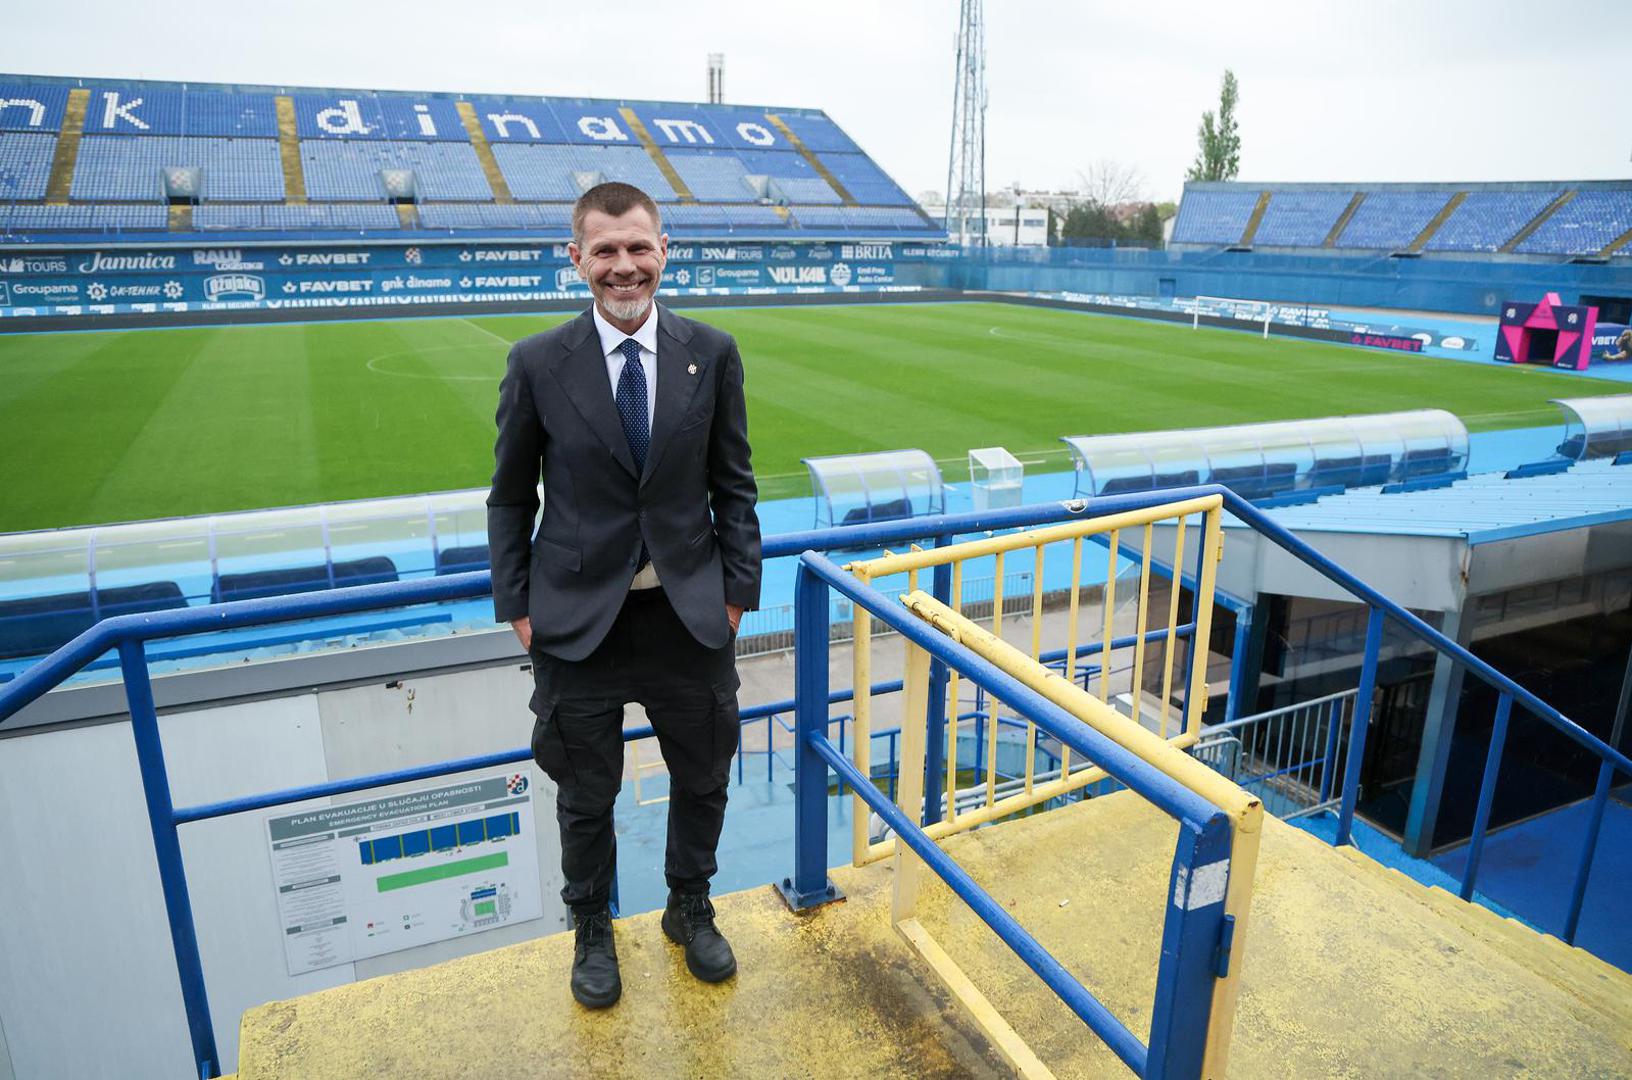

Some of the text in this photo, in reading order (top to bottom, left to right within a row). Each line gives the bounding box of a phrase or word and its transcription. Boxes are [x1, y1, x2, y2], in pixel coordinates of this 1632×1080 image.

[296, 253, 371, 265] FAVBET
[474, 250, 543, 262] FAVBET
[855, 245, 894, 260] BRITA
[25, 261, 67, 272] TOURS
[79, 251, 176, 273] Jamnica
[300, 280, 373, 293] FAVBET
[381, 276, 405, 292] gnk
[474, 276, 542, 288] FAVBET
[13, 283, 79, 297] Groupama
[1363, 334, 1421, 352] FAVBET
[291, 815, 317, 827] PLAN
[379, 800, 387, 810] U
[431, 784, 482, 801] OPASNOSTI
[329, 812, 378, 828] EMERGENCY
[429, 799, 449, 809] PLAN
